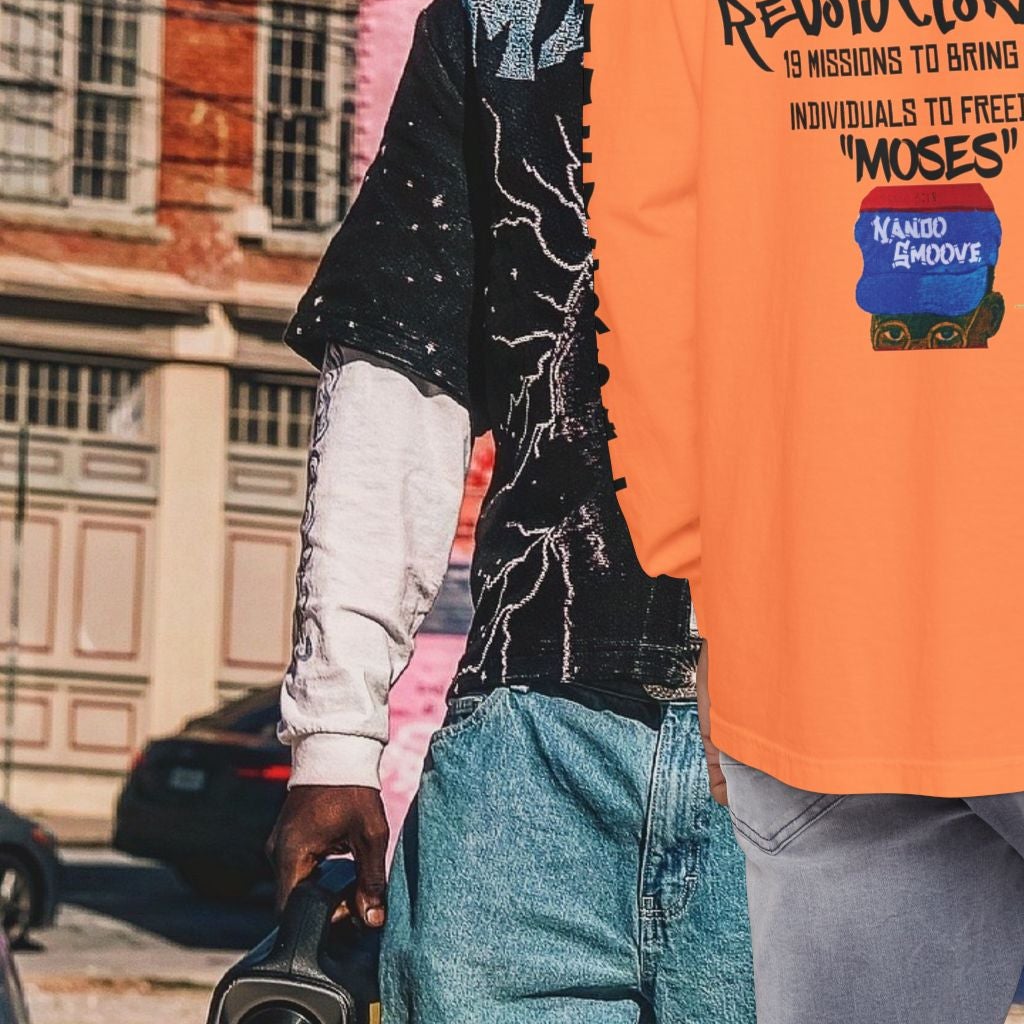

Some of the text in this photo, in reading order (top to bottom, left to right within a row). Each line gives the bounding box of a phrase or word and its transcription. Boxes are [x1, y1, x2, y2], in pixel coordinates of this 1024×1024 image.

[784, 50, 801, 78] 19
[808, 47, 902, 78] MISSIONS
[910, 44, 939, 73] TO
[947, 41, 1018, 70] BRING
[790, 99, 917, 130] INDIVIDUALS
[925, 97, 952, 126] TO
[840, 127, 1017, 183] "MOSES"
[871, 215, 948, 244] NANDO
[892, 240, 982, 269] SMOOVE
